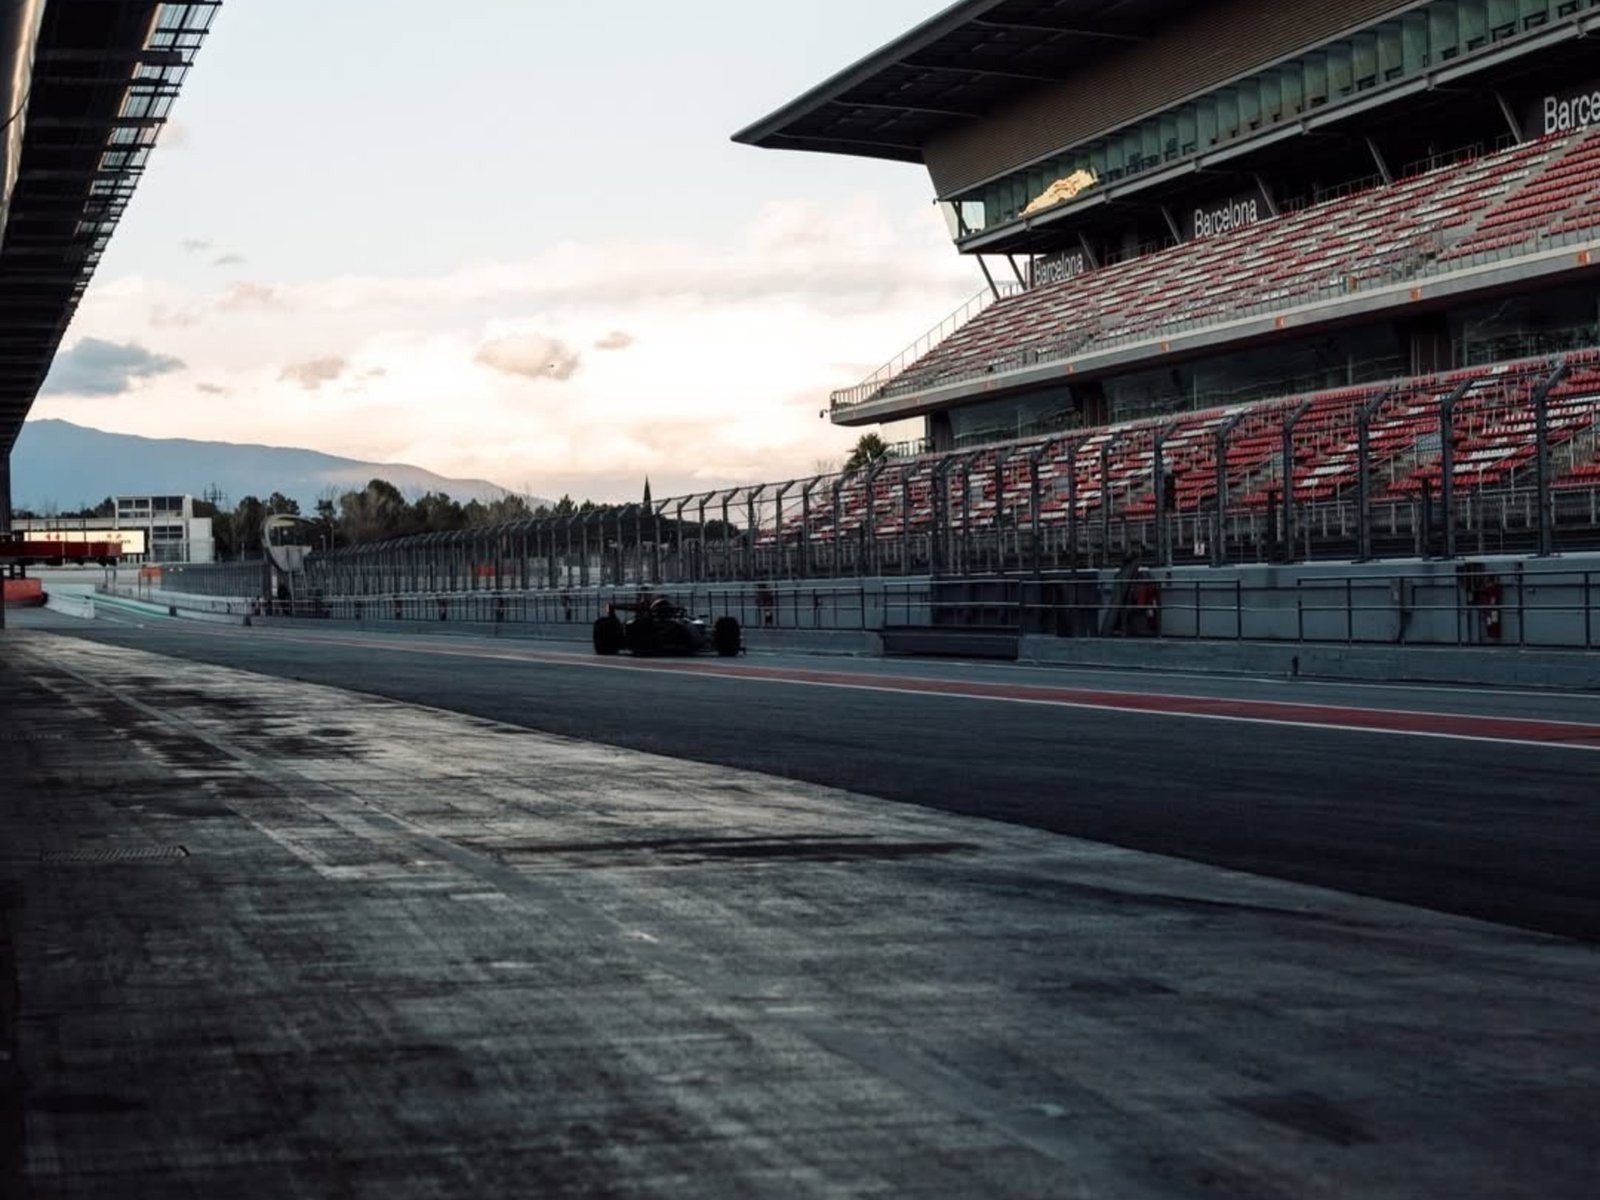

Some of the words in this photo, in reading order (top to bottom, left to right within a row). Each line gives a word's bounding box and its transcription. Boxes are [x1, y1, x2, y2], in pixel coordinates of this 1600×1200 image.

[1544, 91, 1600, 135] Barce
[1194, 197, 1258, 239] Barcelona
[1034, 251, 1084, 286] Barcelona
